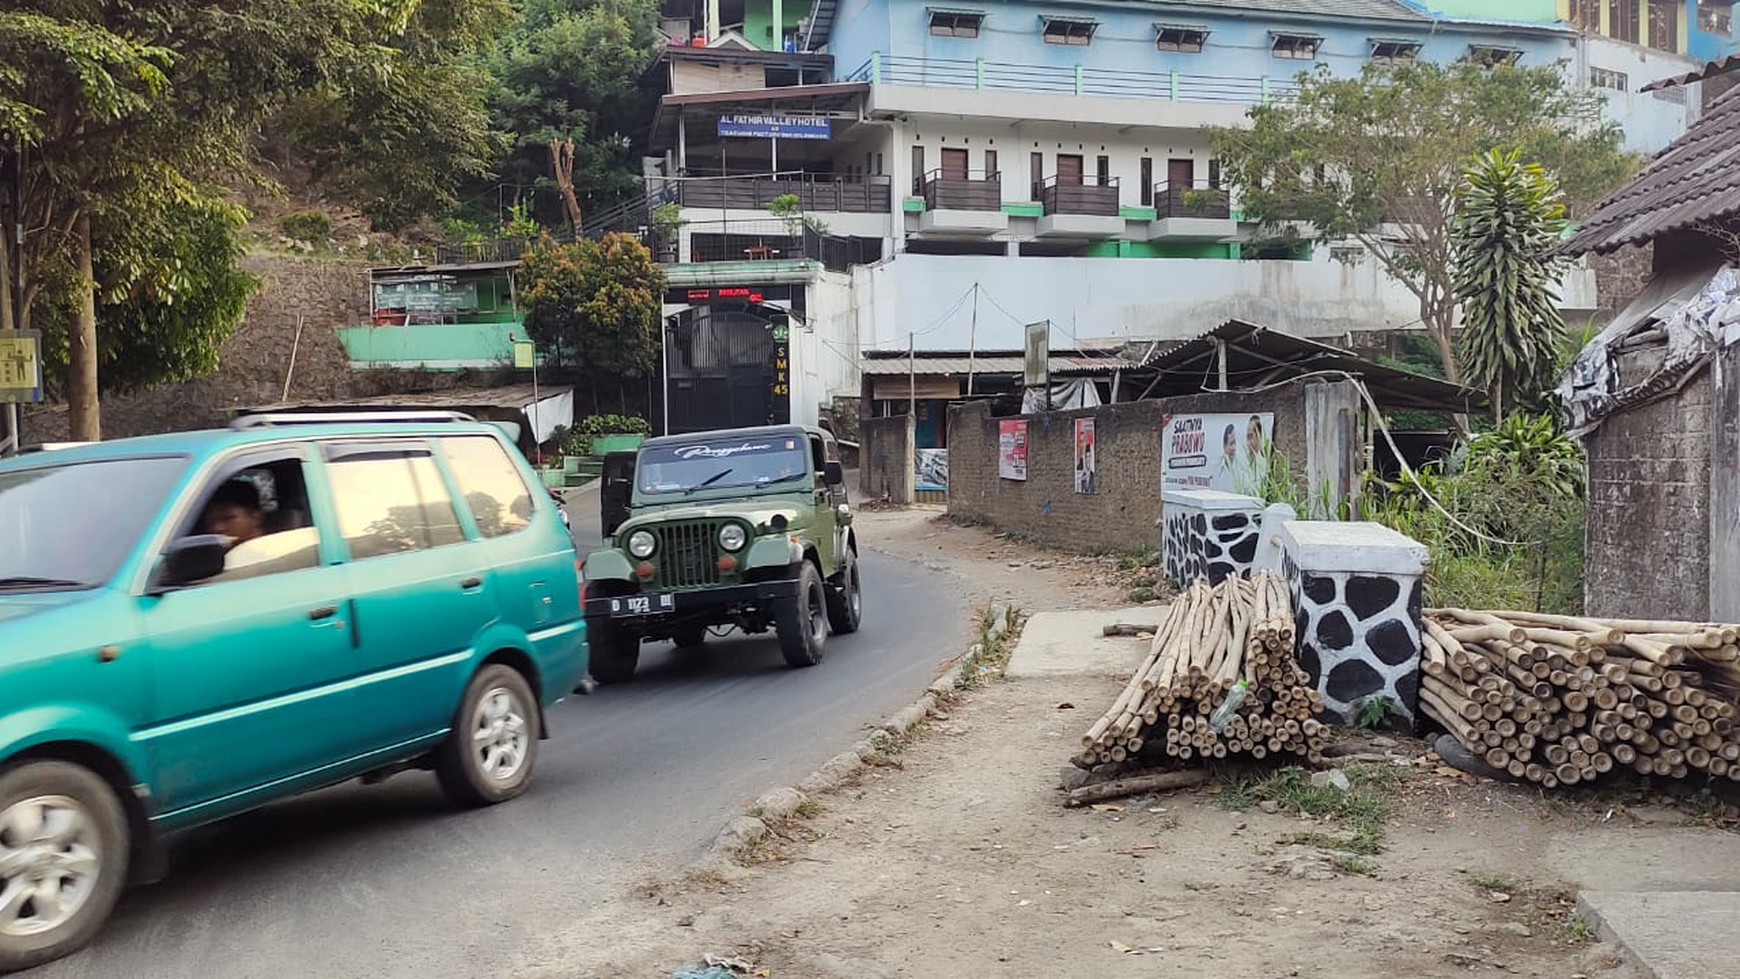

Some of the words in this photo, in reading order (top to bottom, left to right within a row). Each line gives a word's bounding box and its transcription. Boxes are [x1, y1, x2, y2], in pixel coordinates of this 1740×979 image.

[720, 115, 732, 124] AL
[733, 116, 762, 125] FATHIR
[761, 116, 798, 126] VALLEY
[798, 117, 828, 127] HOTEL
[776, 347, 787, 382] SMK
[773, 384, 788, 395] 45
[1174, 417, 1203, 434] SAATNYA
[1172, 432, 1205, 455] PRABOWO
[611, 599, 620, 611] D
